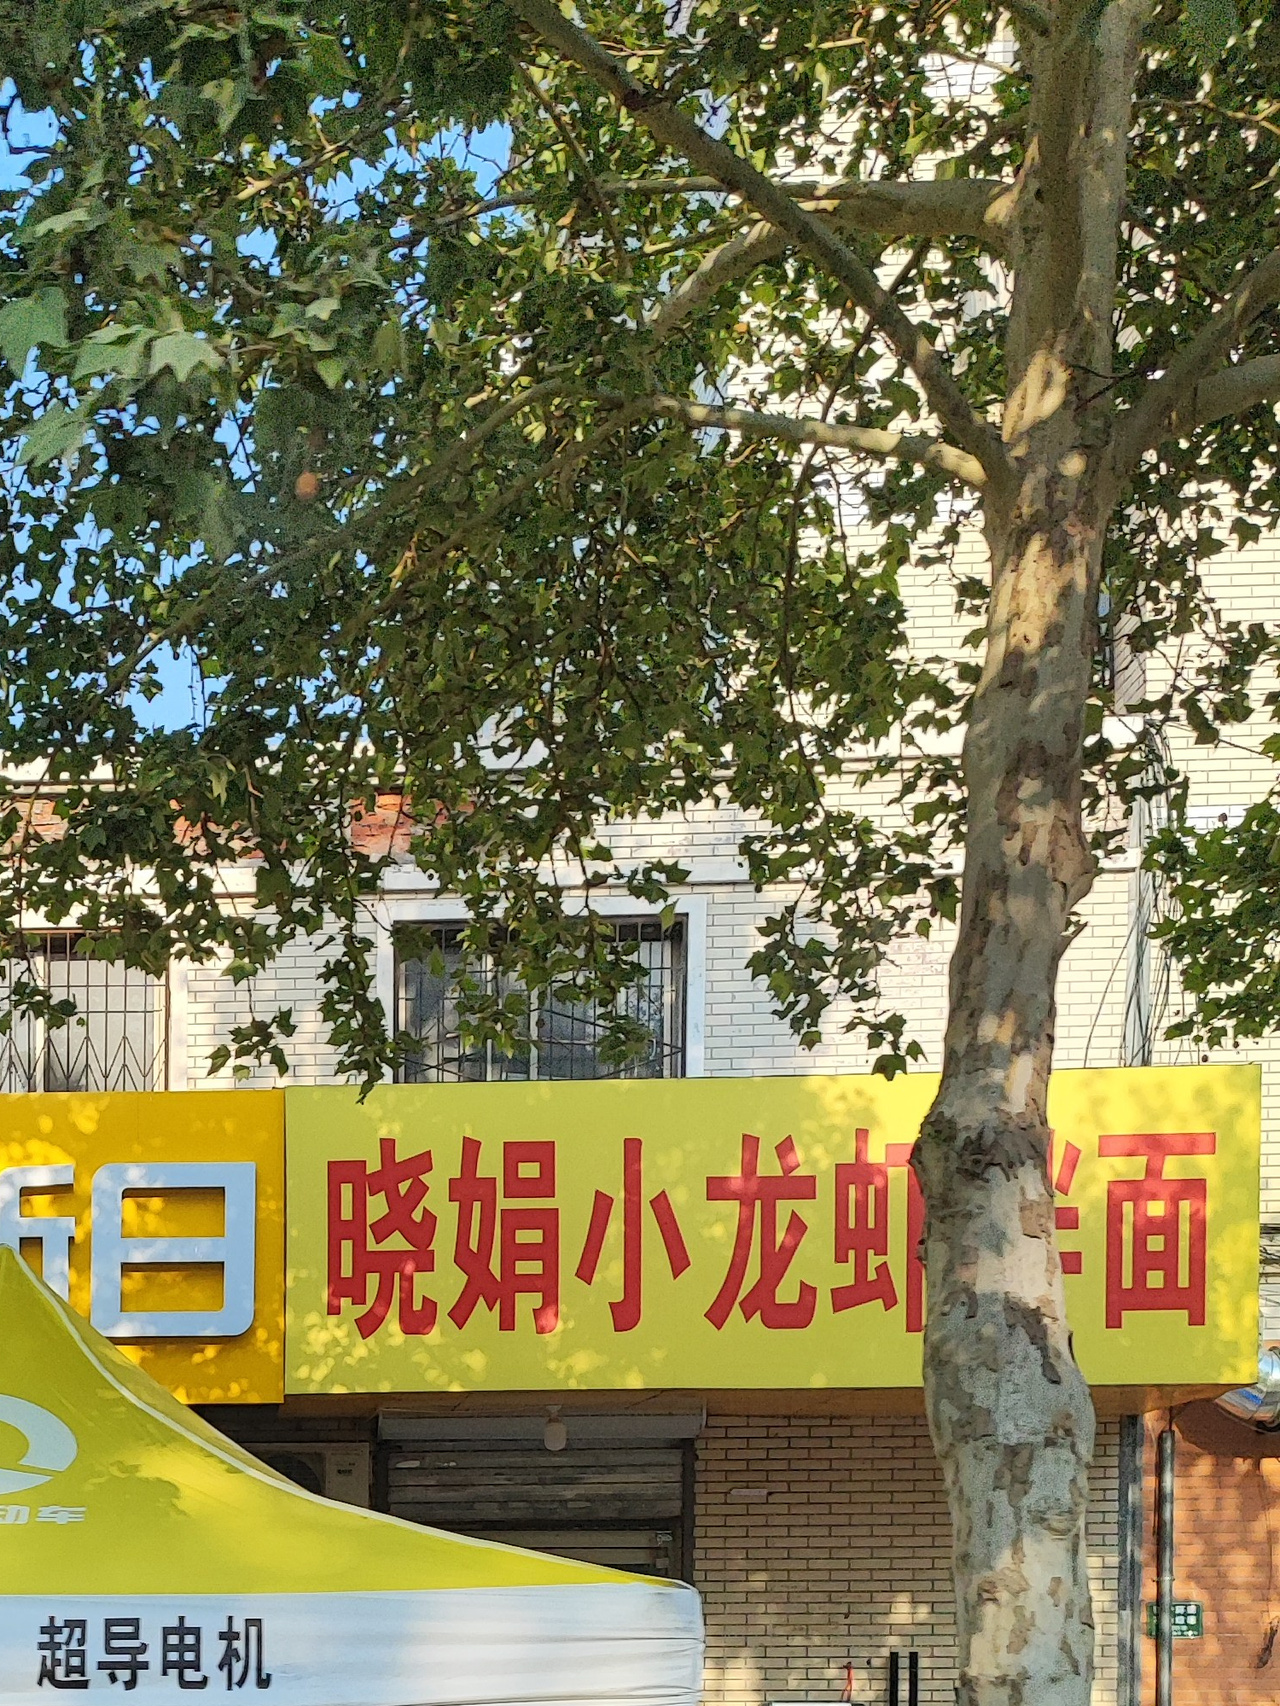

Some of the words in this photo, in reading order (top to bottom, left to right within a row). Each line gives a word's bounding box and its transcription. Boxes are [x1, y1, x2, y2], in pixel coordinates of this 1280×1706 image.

[326, 1128, 1217, 1338] 晓娟小龙虾面
[36, 1614, 273, 1691] 超导电机
